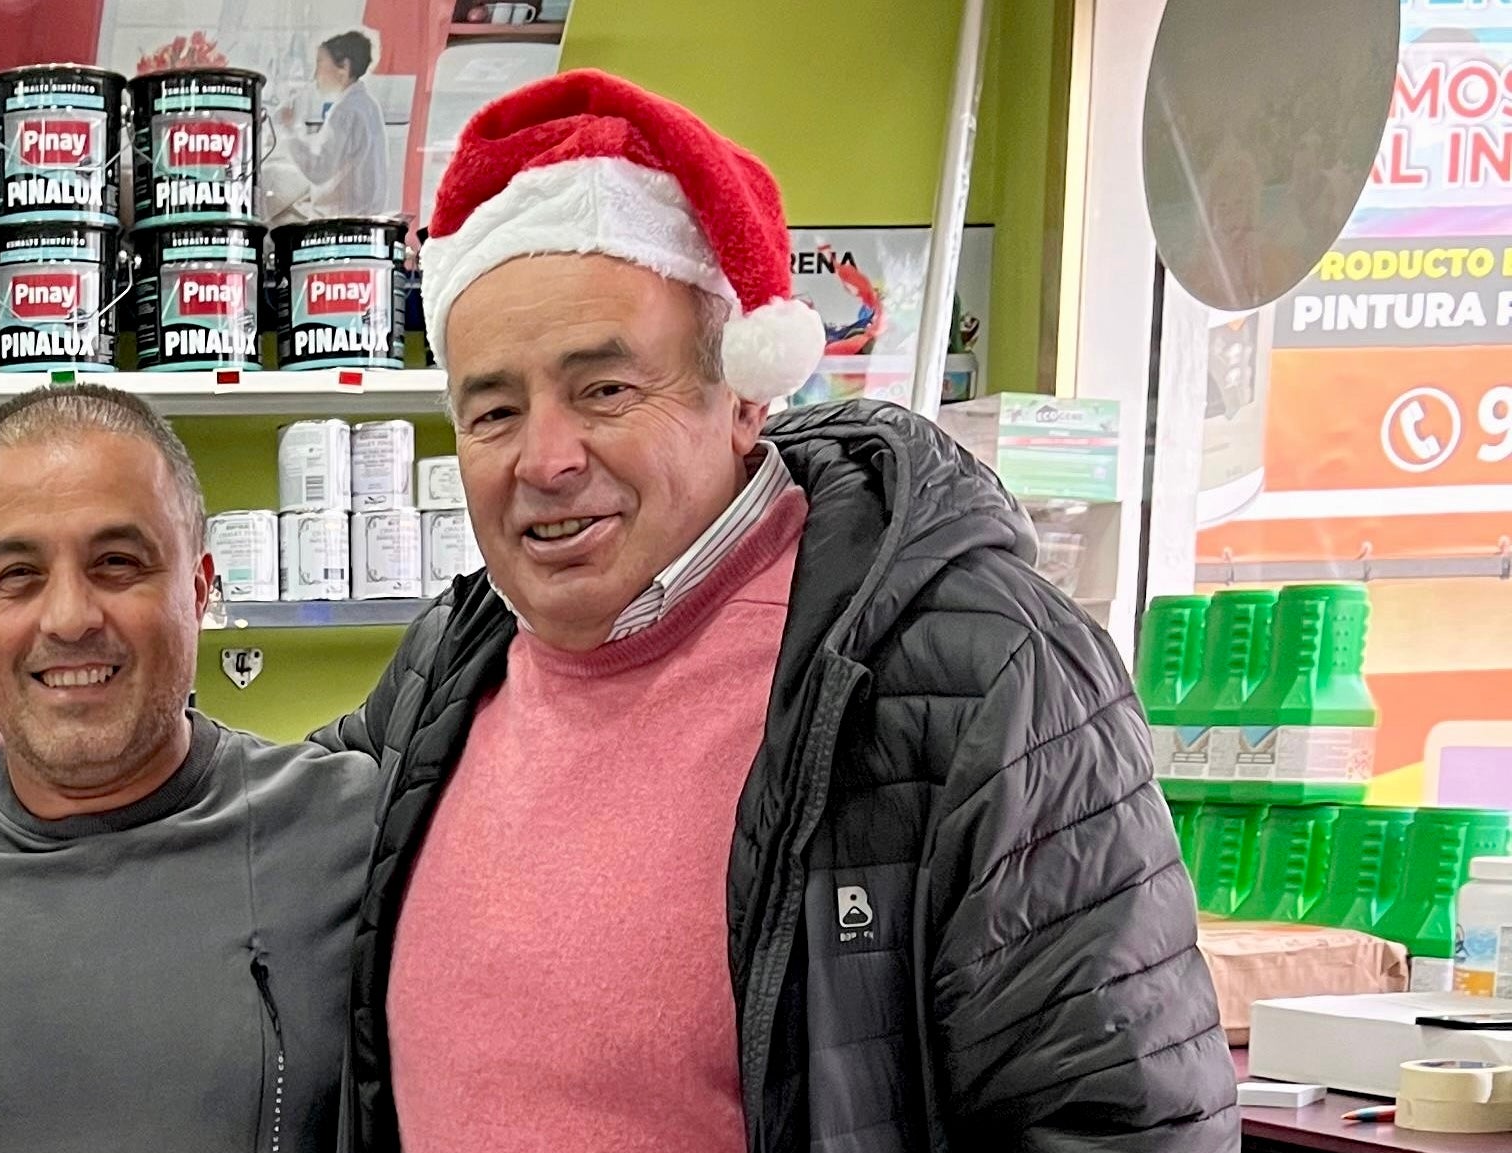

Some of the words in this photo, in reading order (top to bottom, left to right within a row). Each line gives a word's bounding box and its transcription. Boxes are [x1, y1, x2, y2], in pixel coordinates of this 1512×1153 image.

[24, 130, 86, 156] Pinay
[173, 131, 235, 158] Pinay
[8, 178, 102, 207] PINALUX
[156, 180, 251, 209] PINALUX
[1310, 247, 1494, 282] RODUCTO
[15, 283, 77, 308] Pinay
[183, 281, 243, 306] Pinay
[310, 281, 372, 304] Pinay
[1292, 291, 1487, 332] PINTURA
[1, 331, 95, 359] PINALUX
[165, 328, 256, 356] PINALUX
[294, 327, 389, 355] PINALUX
[1477, 385, 1512, 463] 9
